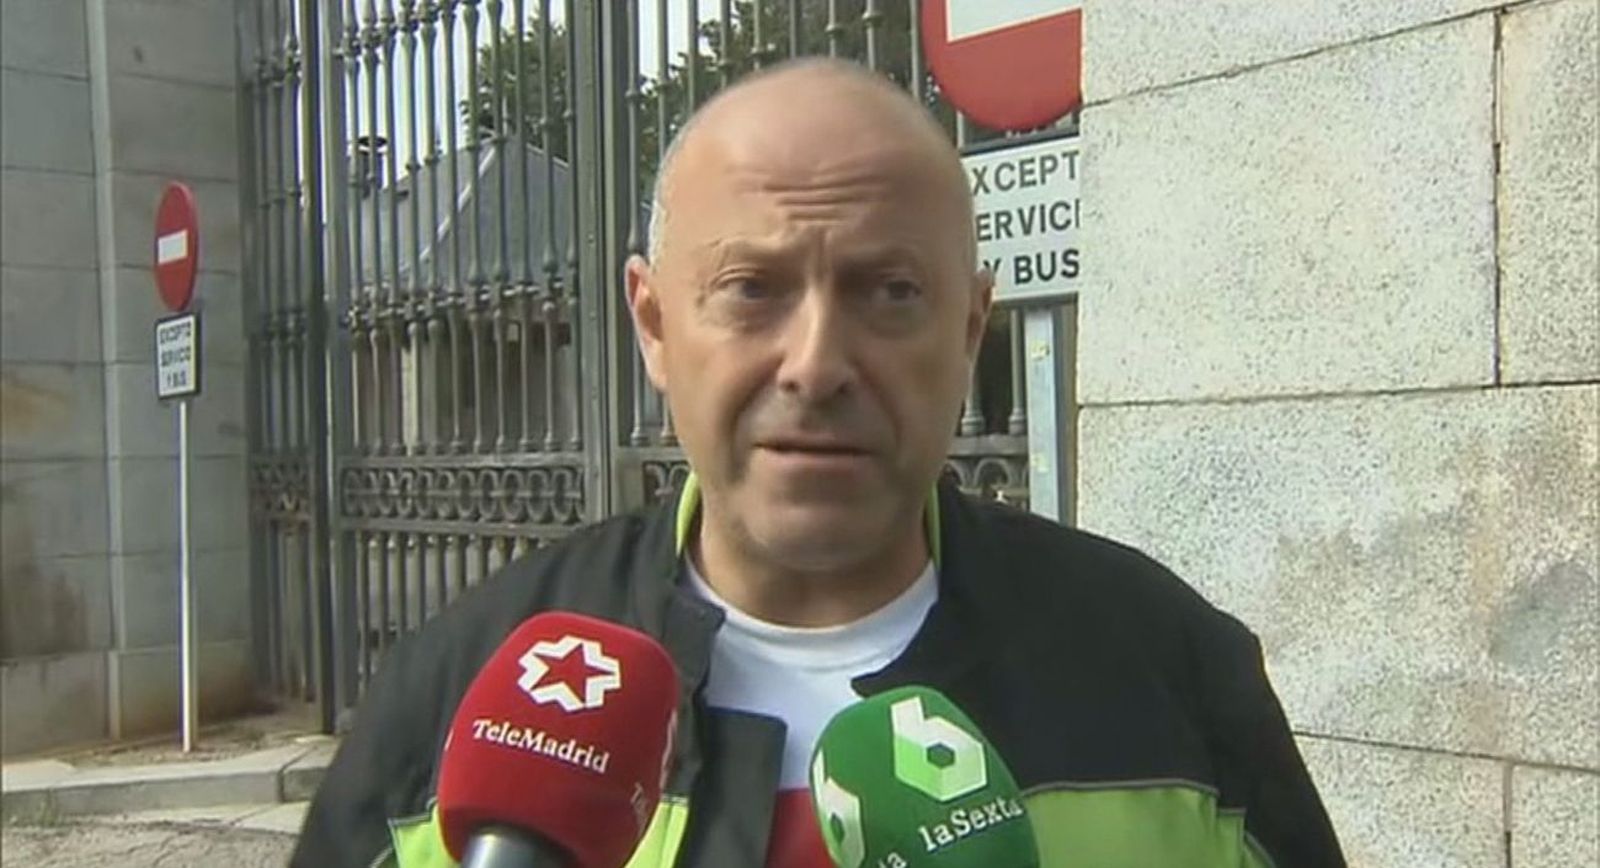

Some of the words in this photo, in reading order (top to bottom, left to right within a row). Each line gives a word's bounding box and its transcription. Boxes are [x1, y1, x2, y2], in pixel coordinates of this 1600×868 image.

[972, 150, 1079, 195] XCEPT
[975, 198, 1079, 241] ERVICI
[1013, 249, 1079, 285] BUS
[472, 718, 610, 774] TeleMadrid
[917, 797, 1025, 852] laSexta
